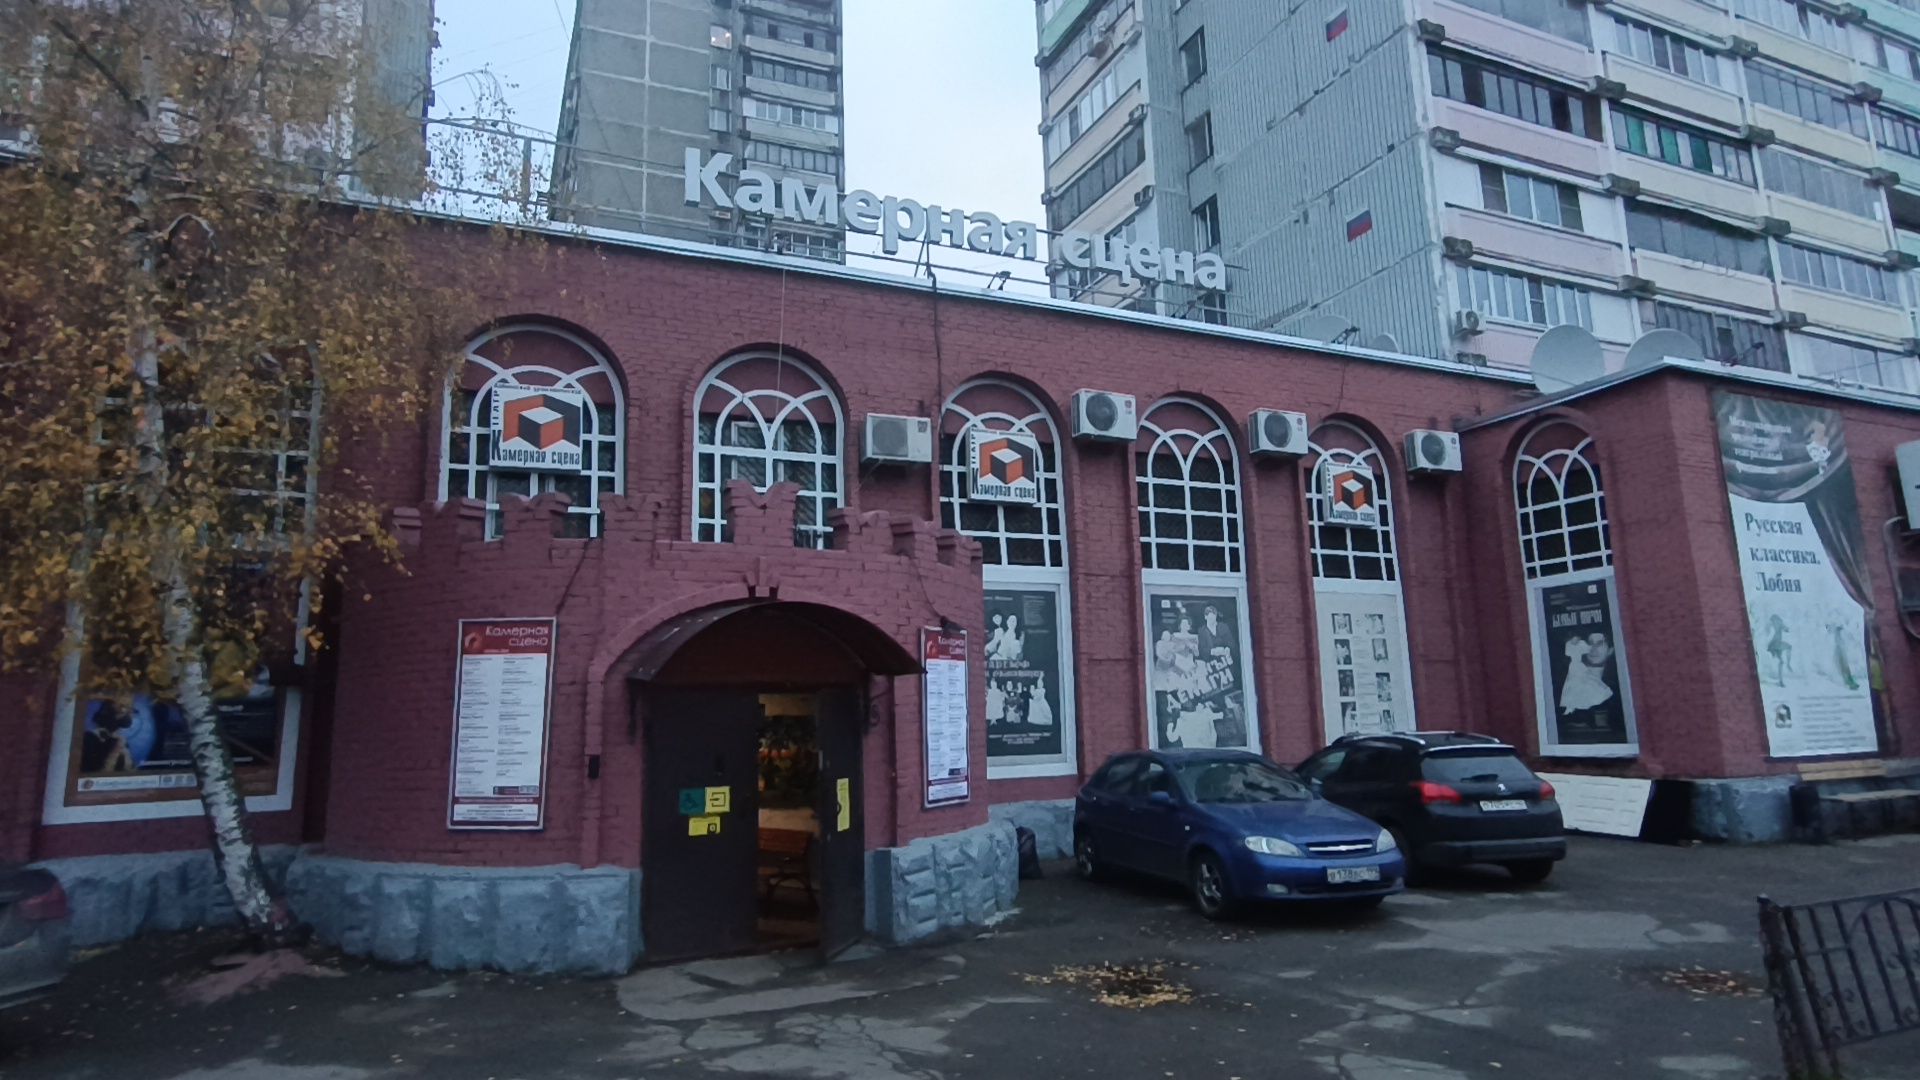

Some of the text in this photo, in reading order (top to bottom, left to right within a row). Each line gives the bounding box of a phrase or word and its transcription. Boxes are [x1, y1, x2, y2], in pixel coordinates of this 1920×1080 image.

[684, 147, 1226, 292] Камерная сцена
[491, 430, 580, 466] Камерная сцена
[1744, 512, 1804, 537] Русская
[1749, 547, 1821, 565] классика.
[1755, 571, 1803, 593] Лобня
[485, 625, 549, 638] Камерная
